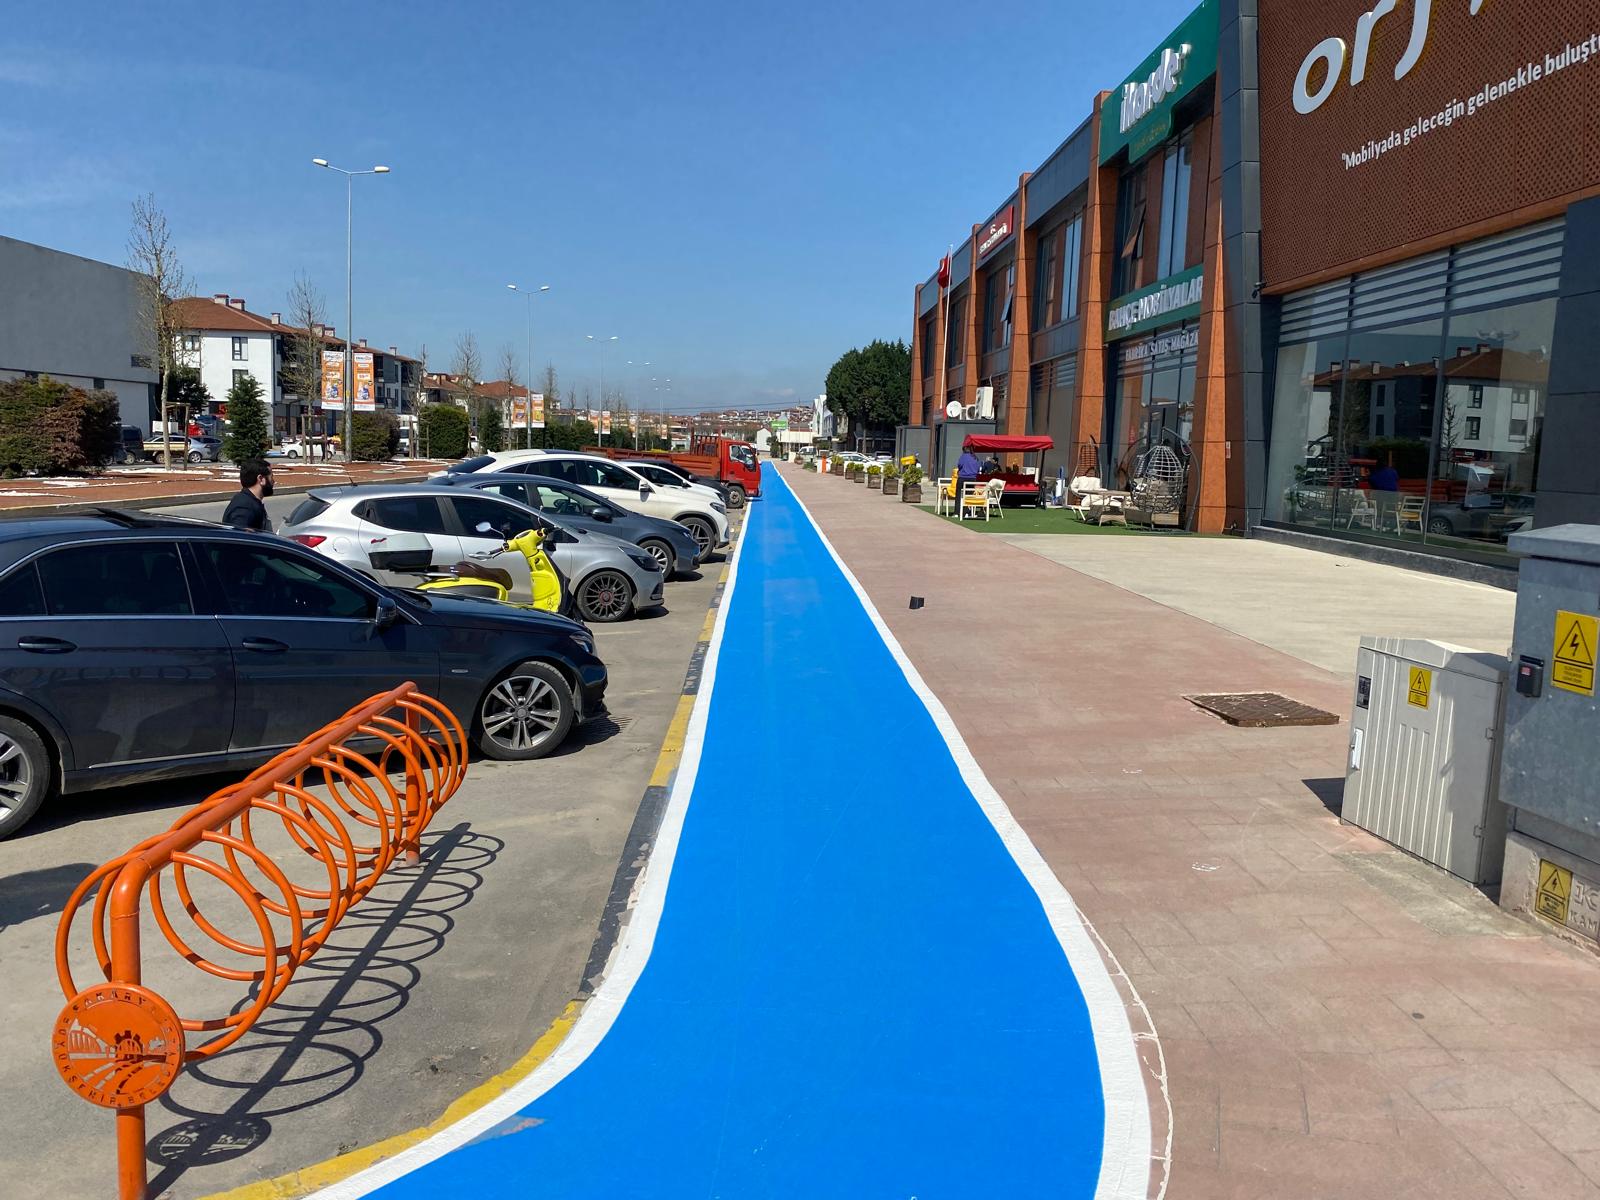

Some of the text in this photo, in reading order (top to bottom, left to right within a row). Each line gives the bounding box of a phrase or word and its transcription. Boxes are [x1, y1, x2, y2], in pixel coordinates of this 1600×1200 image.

[1293, 0, 1486, 115] orj
[1403, 98, 1465, 146] geleceğin
[1468, 62, 1542, 115] gelenekle
